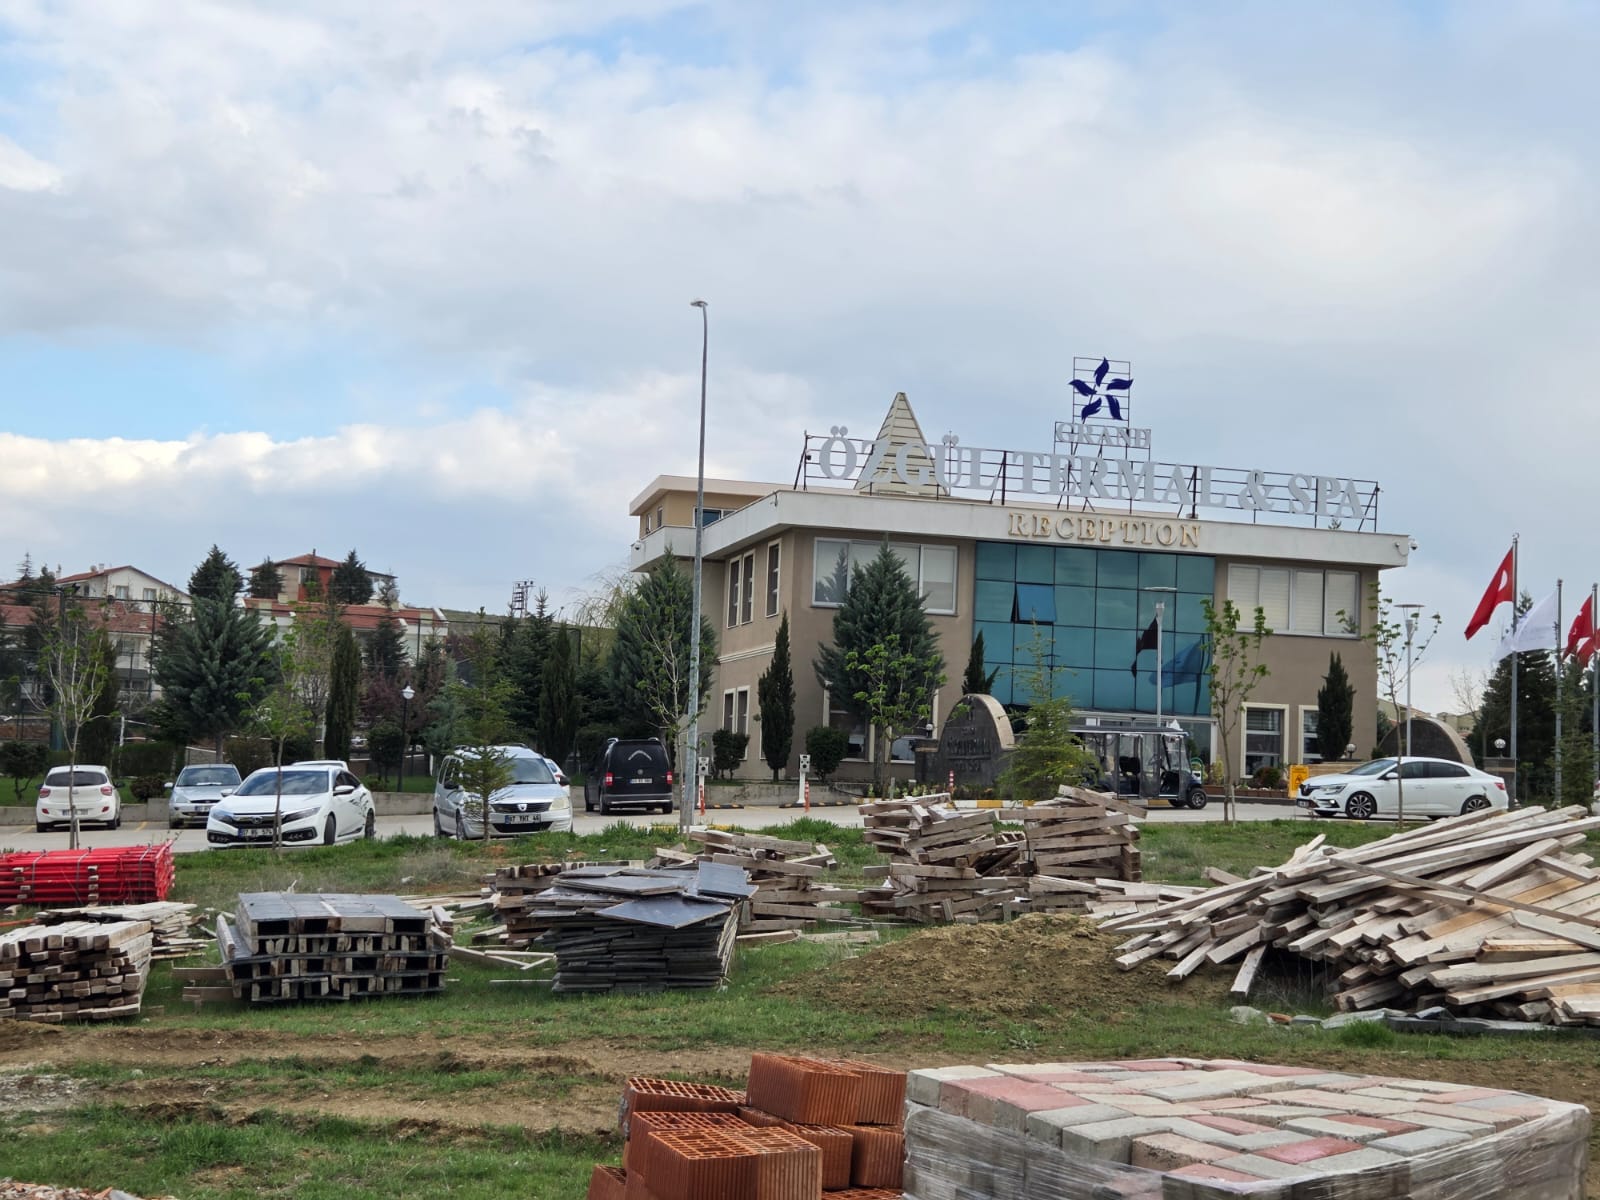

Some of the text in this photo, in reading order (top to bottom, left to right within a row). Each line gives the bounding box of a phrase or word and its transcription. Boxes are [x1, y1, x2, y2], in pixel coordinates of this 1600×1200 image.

[1056, 423, 1151, 448] GRAND
[819, 425, 1365, 520] ÖZGÜL TERMAL & SPA
[1008, 512, 1201, 548] RECEPTION
